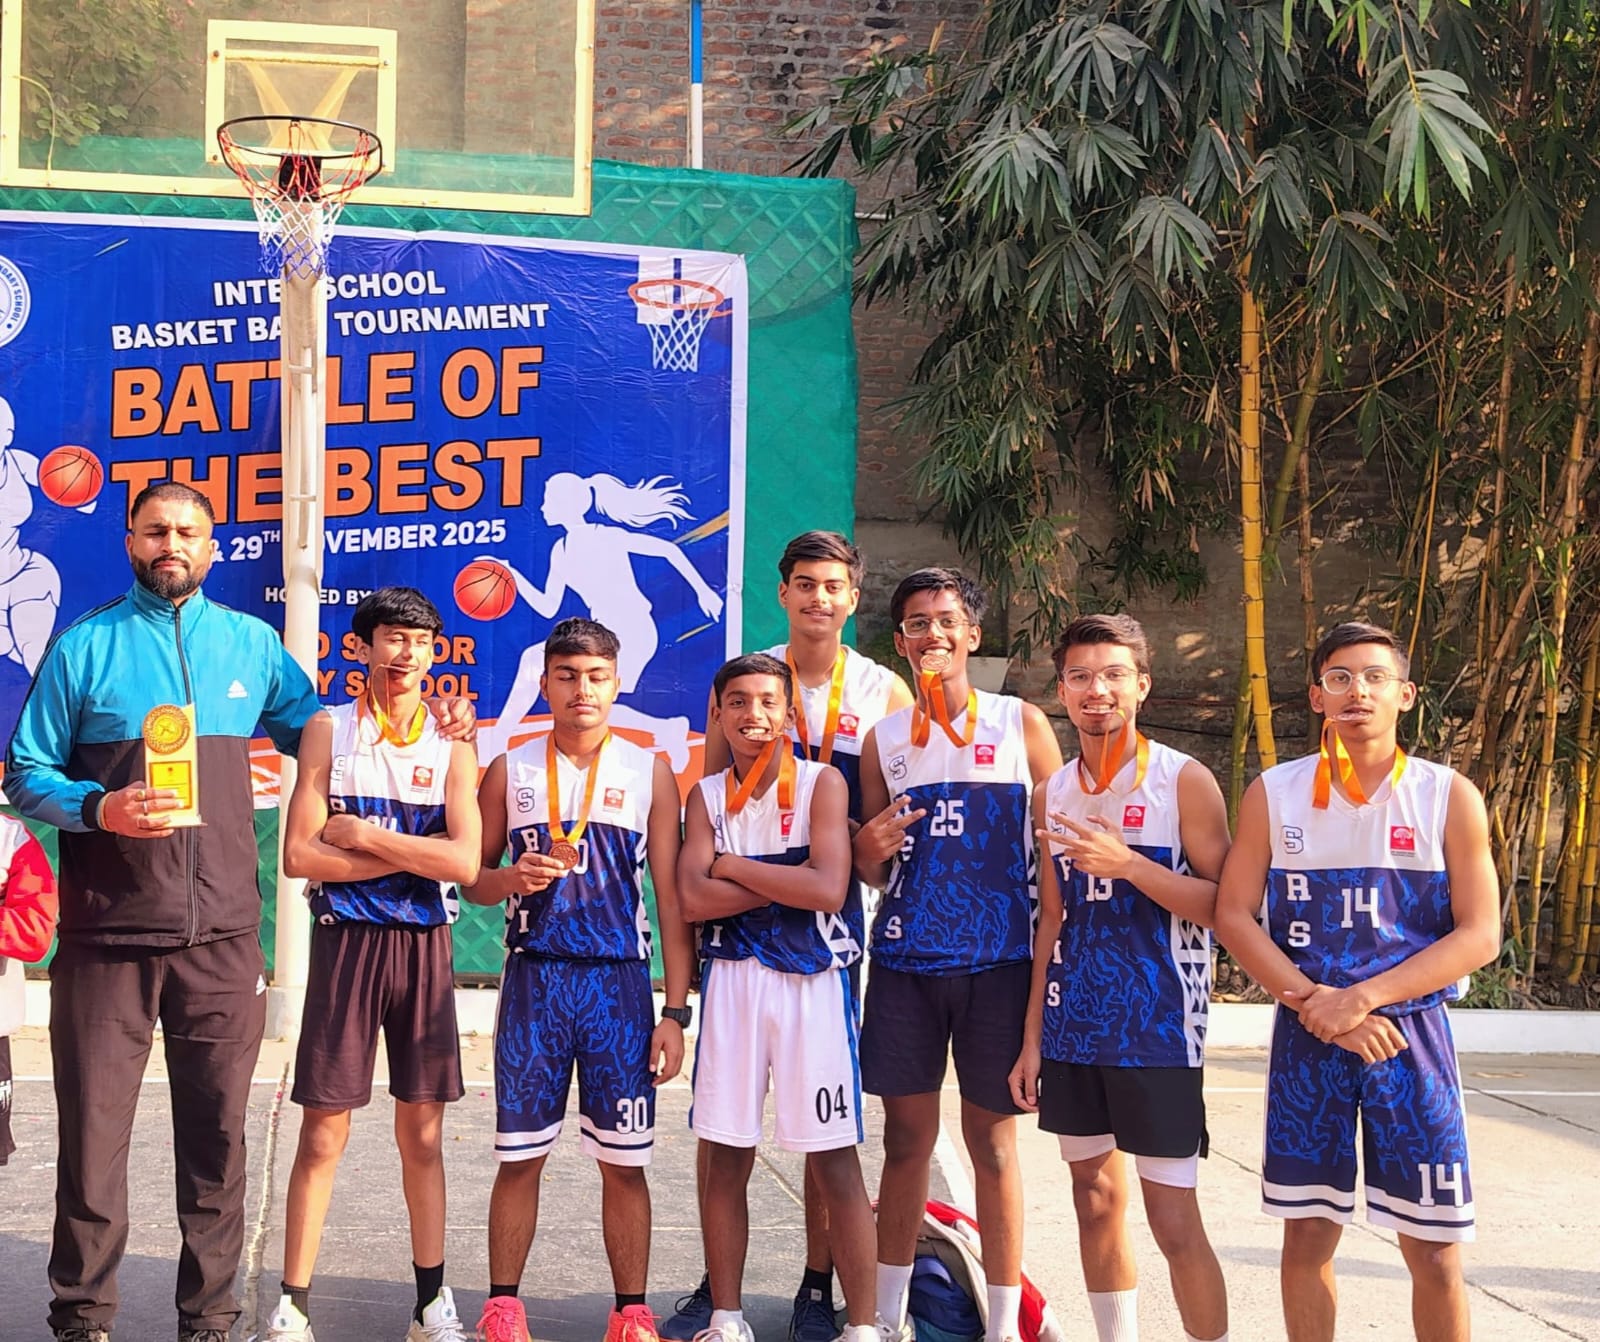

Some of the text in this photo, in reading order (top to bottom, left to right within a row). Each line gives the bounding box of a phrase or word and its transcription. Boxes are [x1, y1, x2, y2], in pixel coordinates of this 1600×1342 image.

[10, 289, 24, 322] SCHOOL
[214, 279, 281, 306] INTE
[111, 303, 549, 350] BASKET BA TOURNAMENT
[111, 346, 544, 438] BATLE OF
[110, 436, 542, 532] THE BEST
[322, 523, 437, 555] VEMBER
[441, 518, 507, 547] 2025
[930, 799, 964, 837] 25
[1340, 887, 1381, 929] 14
[615, 1095, 648, 1134] 30
[815, 1083, 848, 1124] 04
[1417, 1162, 1465, 1208] 14
